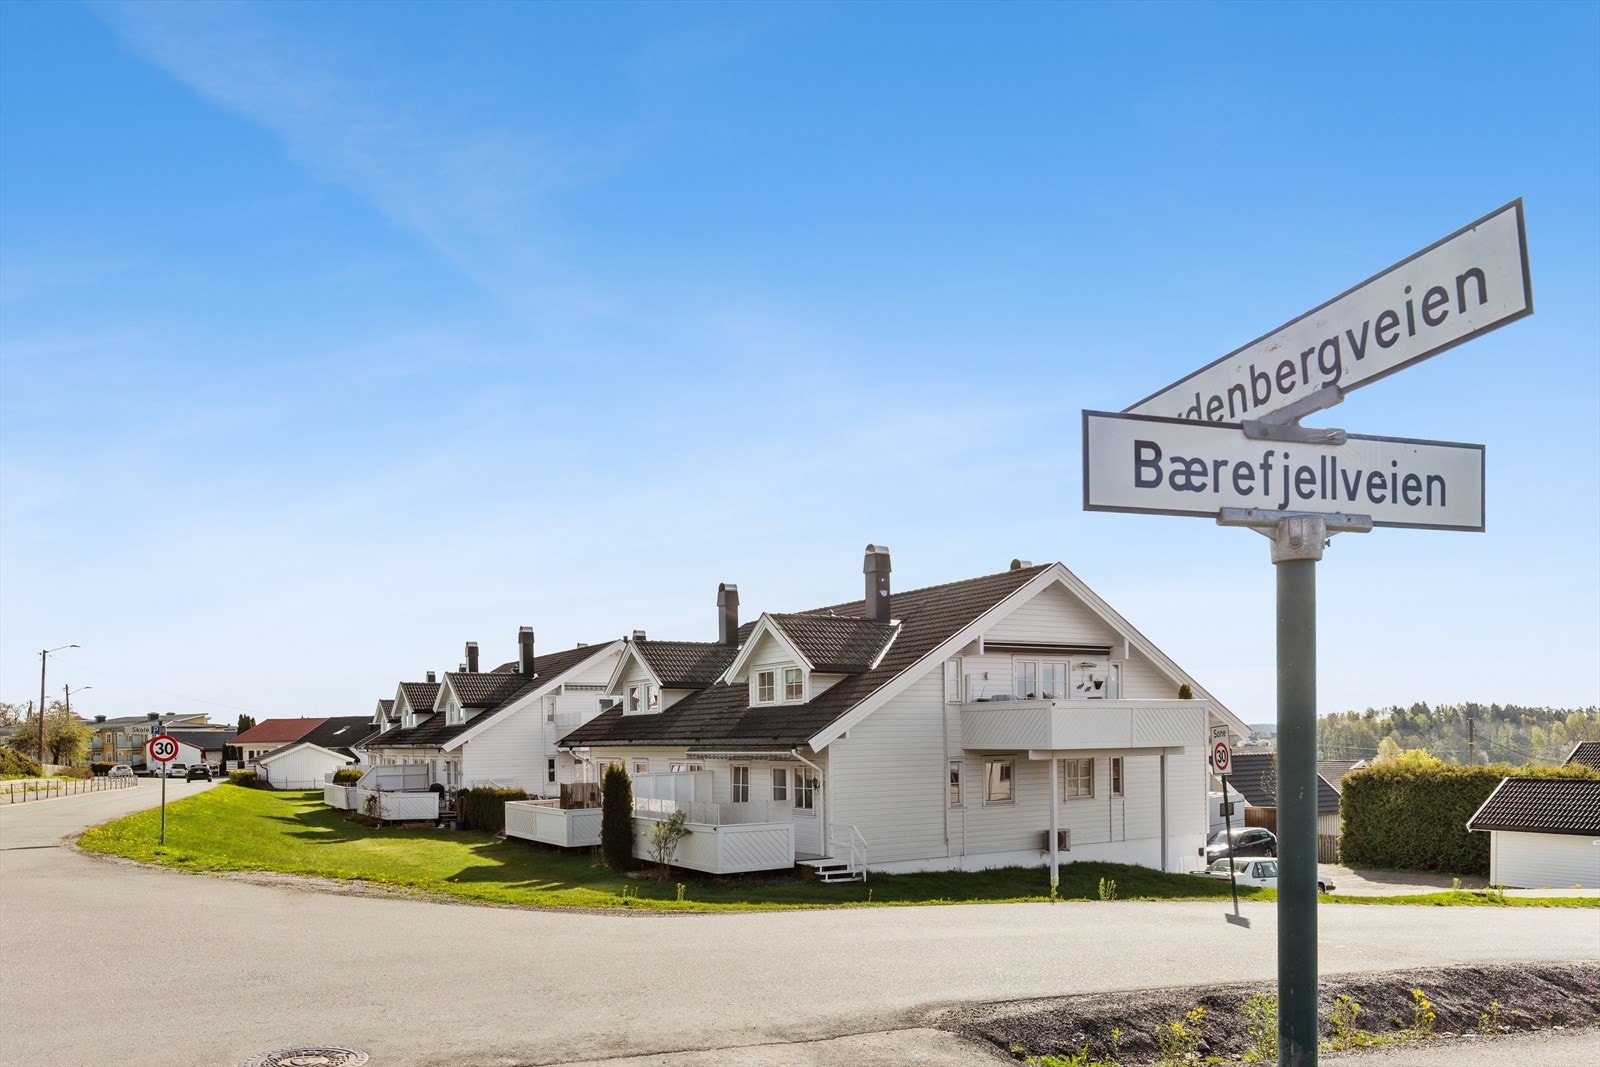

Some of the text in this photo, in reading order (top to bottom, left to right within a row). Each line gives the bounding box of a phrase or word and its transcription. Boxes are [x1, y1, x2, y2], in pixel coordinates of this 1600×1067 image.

[1177, 266, 1489, 423] denbergveien
[1134, 439, 1447, 510] Bærefjellveien
[1213, 729, 1226, 738] Sone
[155, 742, 174, 755] 30
[1217, 749, 1227, 763] 30
